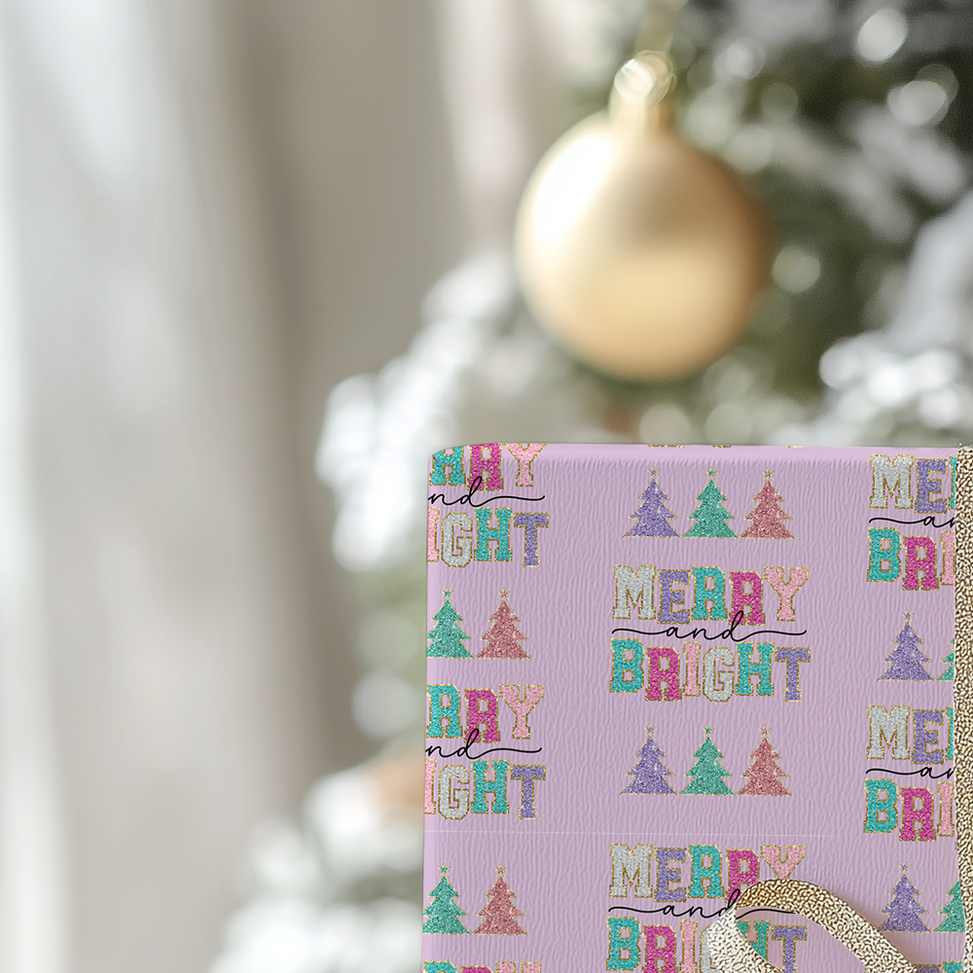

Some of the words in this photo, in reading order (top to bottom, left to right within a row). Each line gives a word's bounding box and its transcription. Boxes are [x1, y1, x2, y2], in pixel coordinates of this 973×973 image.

[428, 476, 545, 507] nd
[430, 443, 547, 491] RRY
[427, 507, 549, 567] IGHT
[612, 565, 809, 625] MERRY
[610, 638, 811, 702] BRIGHT
[426, 684, 545, 743] RRY
[425, 728, 542, 760] nd
[424, 759, 546, 820] IGHT
[609, 843, 806, 903] MERRY
